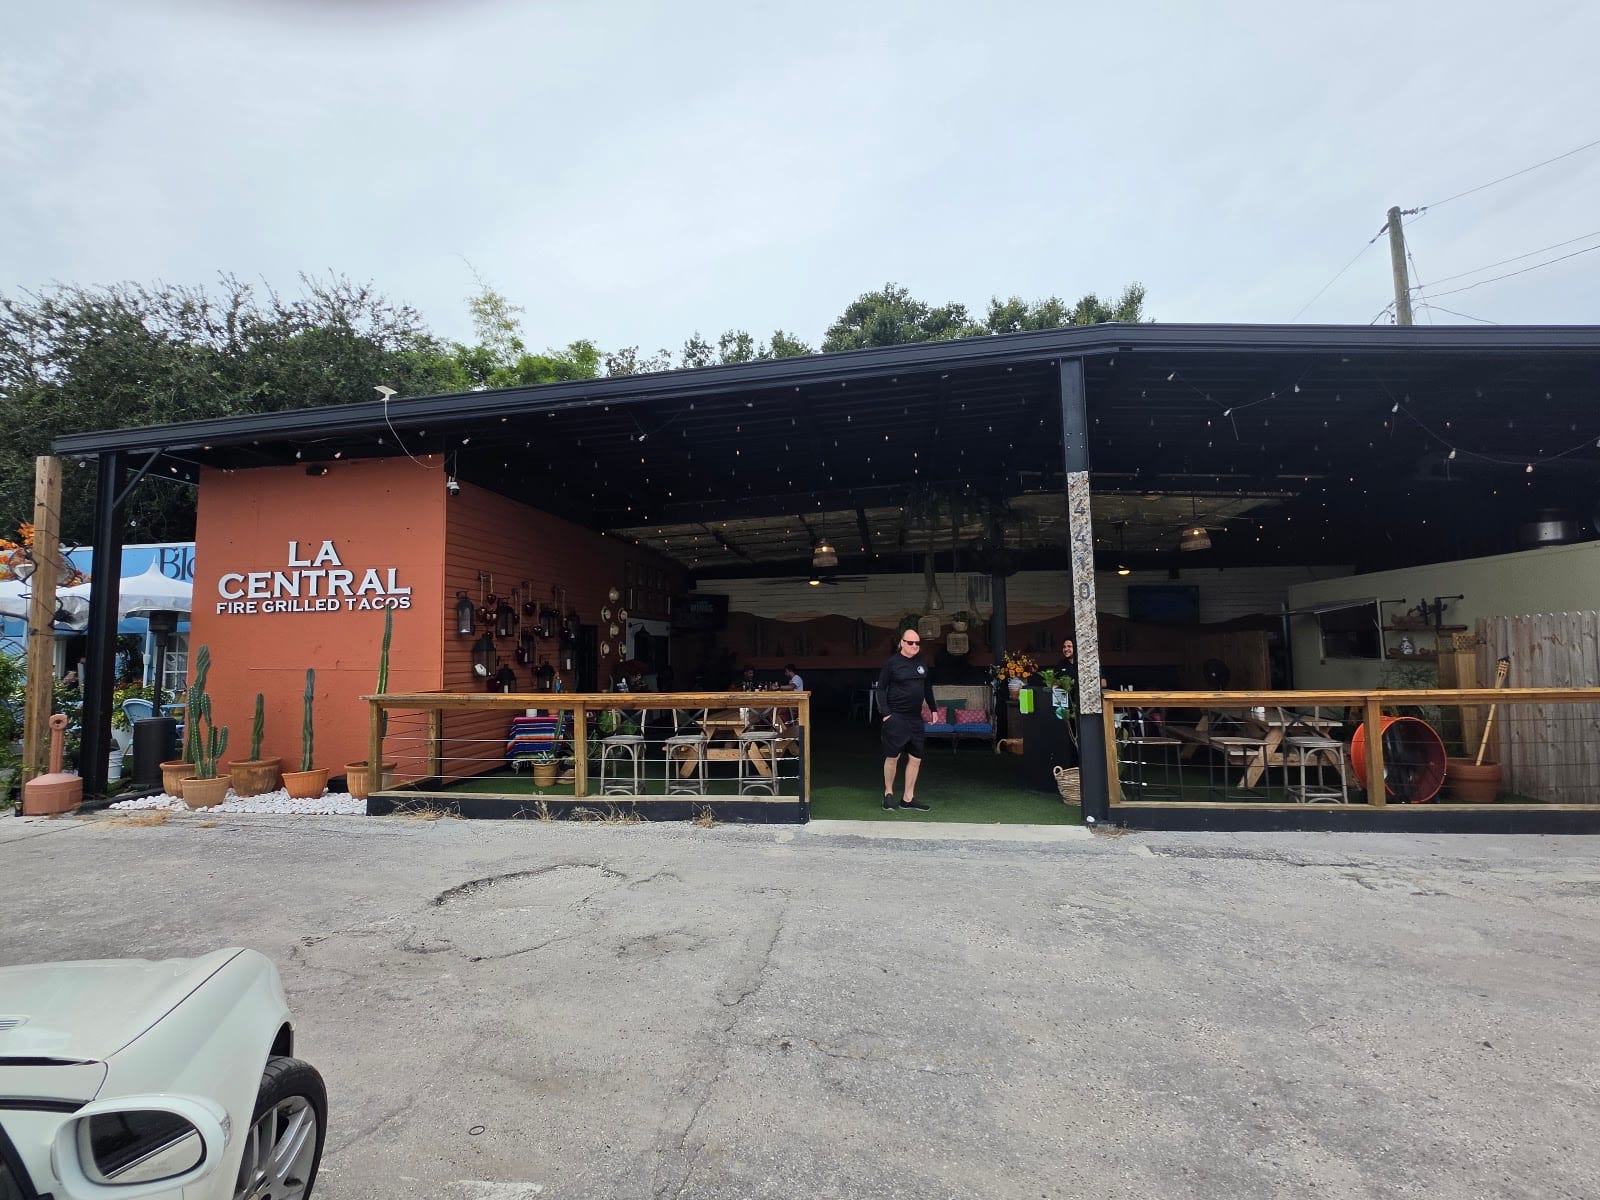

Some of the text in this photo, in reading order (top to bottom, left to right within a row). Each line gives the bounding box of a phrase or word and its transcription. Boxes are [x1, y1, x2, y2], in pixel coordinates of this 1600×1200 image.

[287, 540, 342, 567] LA
[217, 567, 412, 600] CENTRAL
[216, 596, 411, 615] FIRE GRILLED TACOS
